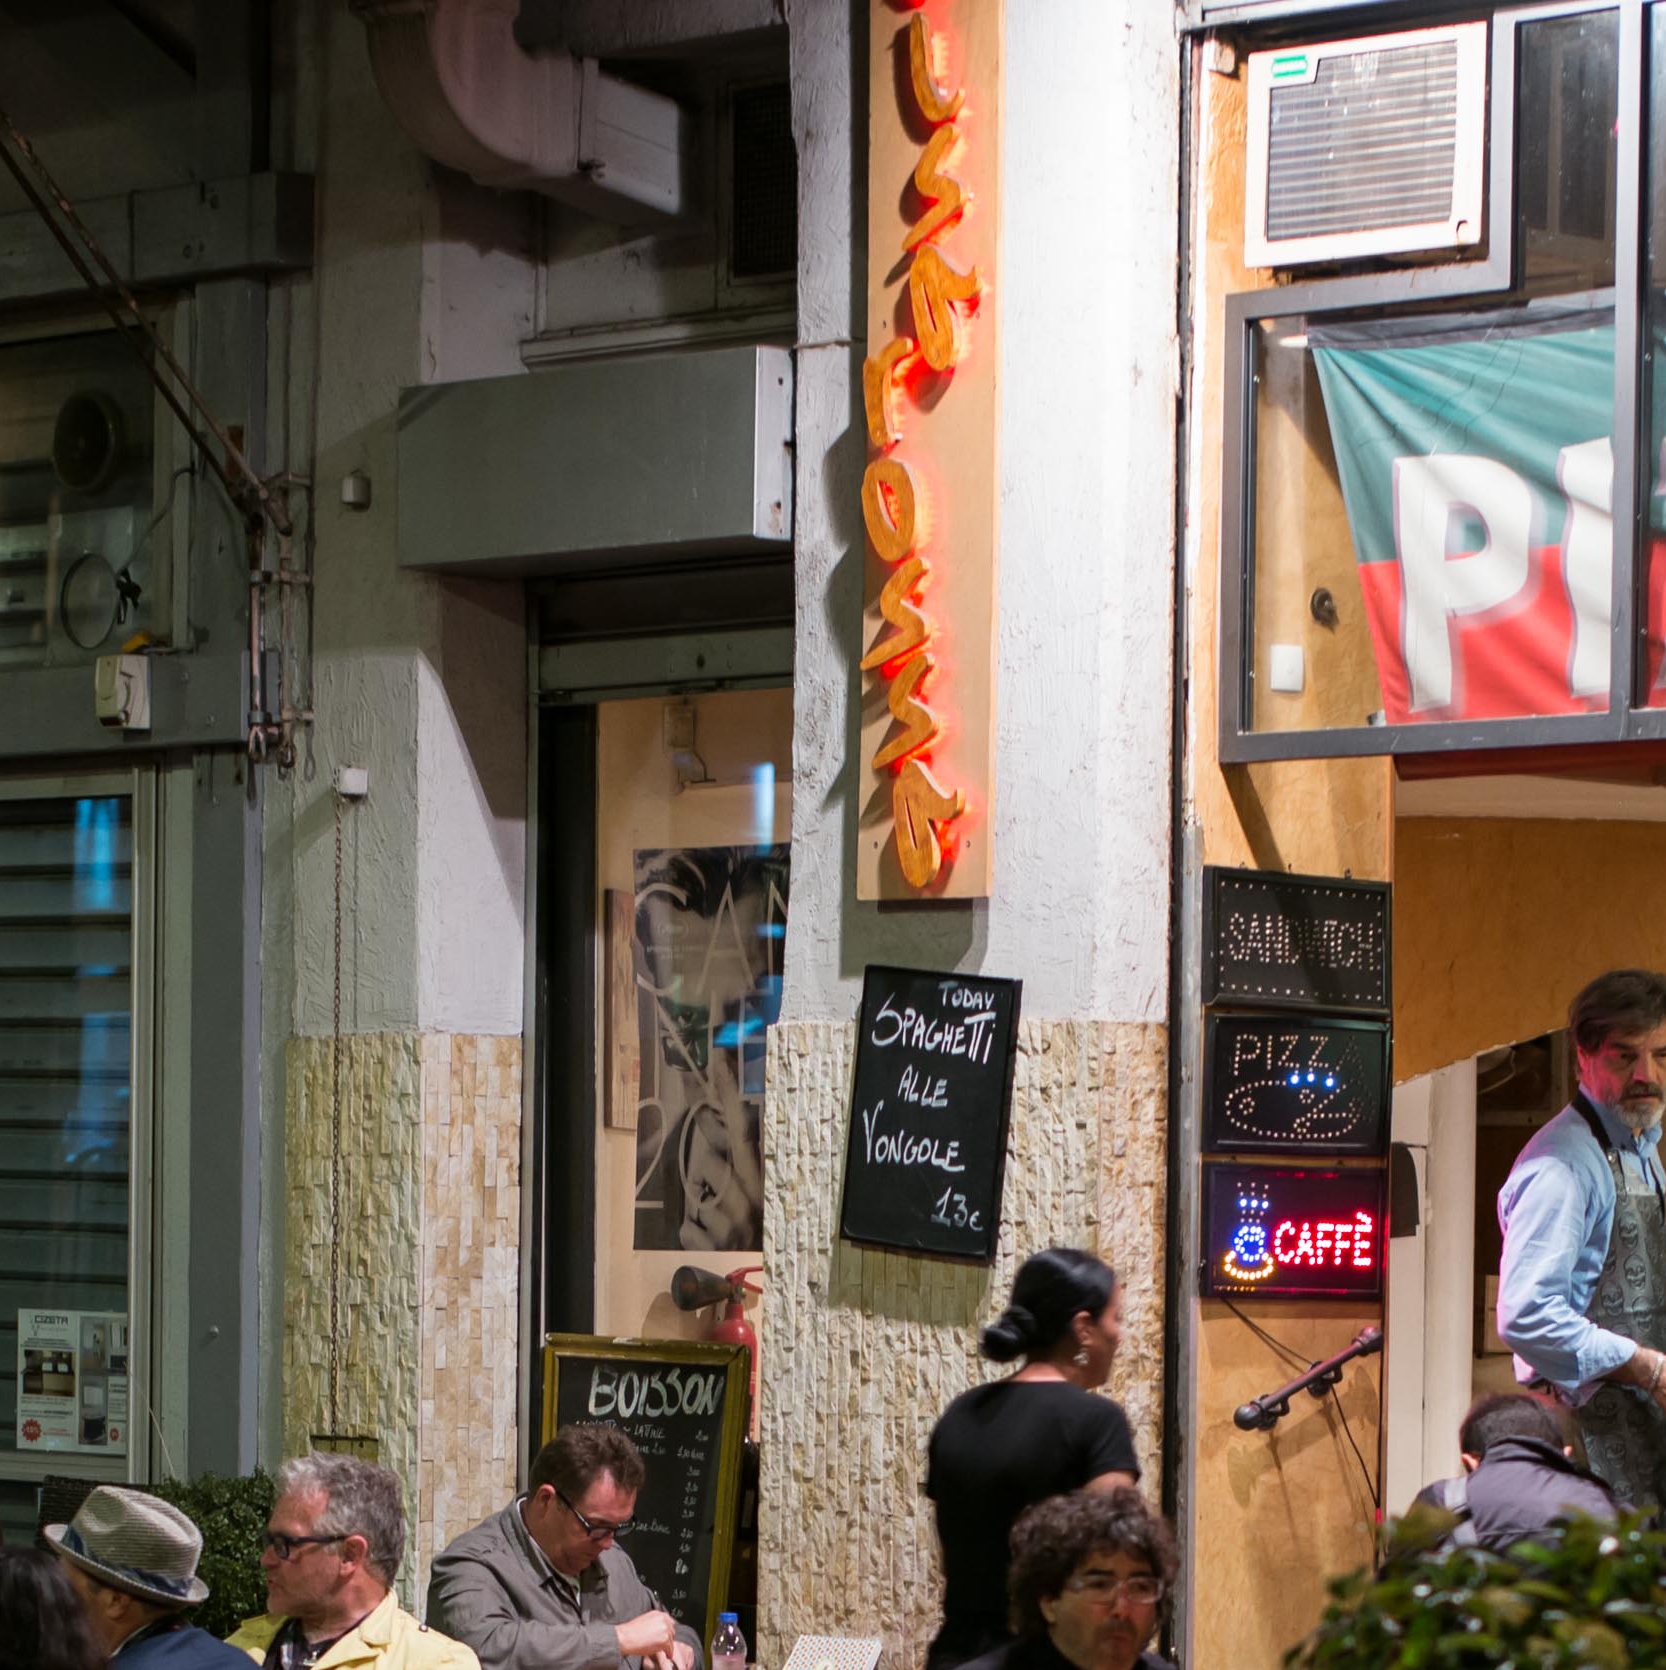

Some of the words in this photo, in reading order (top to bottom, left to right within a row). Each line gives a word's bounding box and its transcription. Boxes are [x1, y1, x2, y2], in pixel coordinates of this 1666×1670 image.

[1226, 911, 1378, 970] SANDWICH
[937, 979, 996, 1010] TODAY
[897, 1062, 949, 1109] ALLE
[1231, 1032, 1373, 1090] PIZZA
[862, 1098, 966, 1173] VONGOLE
[1272, 1210, 1375, 1267] CAFFÈ
